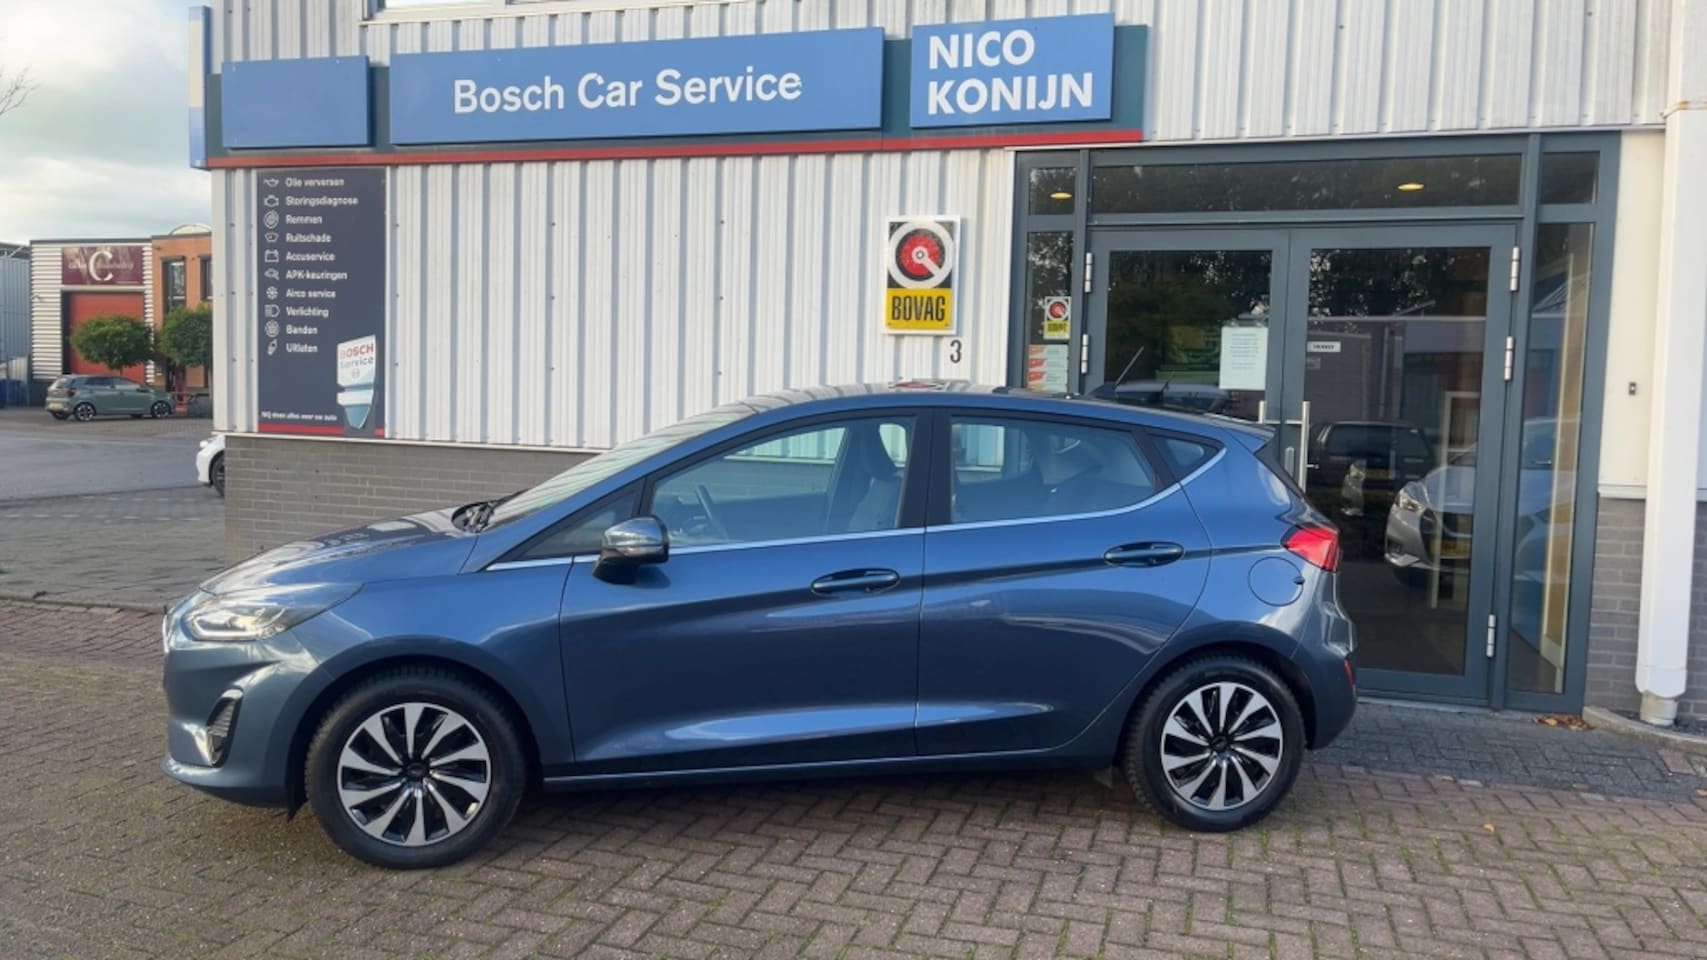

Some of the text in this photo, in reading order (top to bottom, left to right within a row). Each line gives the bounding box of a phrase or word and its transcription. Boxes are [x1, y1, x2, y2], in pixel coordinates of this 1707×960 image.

[929, 29, 1035, 69] NICO
[454, 65, 803, 114] Bosch Car Service
[928, 72, 1093, 115] KONIJN
[285, 177, 345, 187] Olie verversen
[285, 195, 359, 207] Storingsdiagnose
[285, 214, 323, 225] Remmen
[285, 232, 332, 243] Ruitschade
[286, 251, 336, 262] Accuservice
[286, 269, 348, 281] APK-keuringen
[286, 288, 337, 298] Airco service
[286, 306, 330, 318] Verlichting
[892, 295, 946, 321] BOVAG
[286, 324, 319, 335] Banden
[286, 343, 319, 353] Uitlaten
[950, 339, 962, 363] 3
